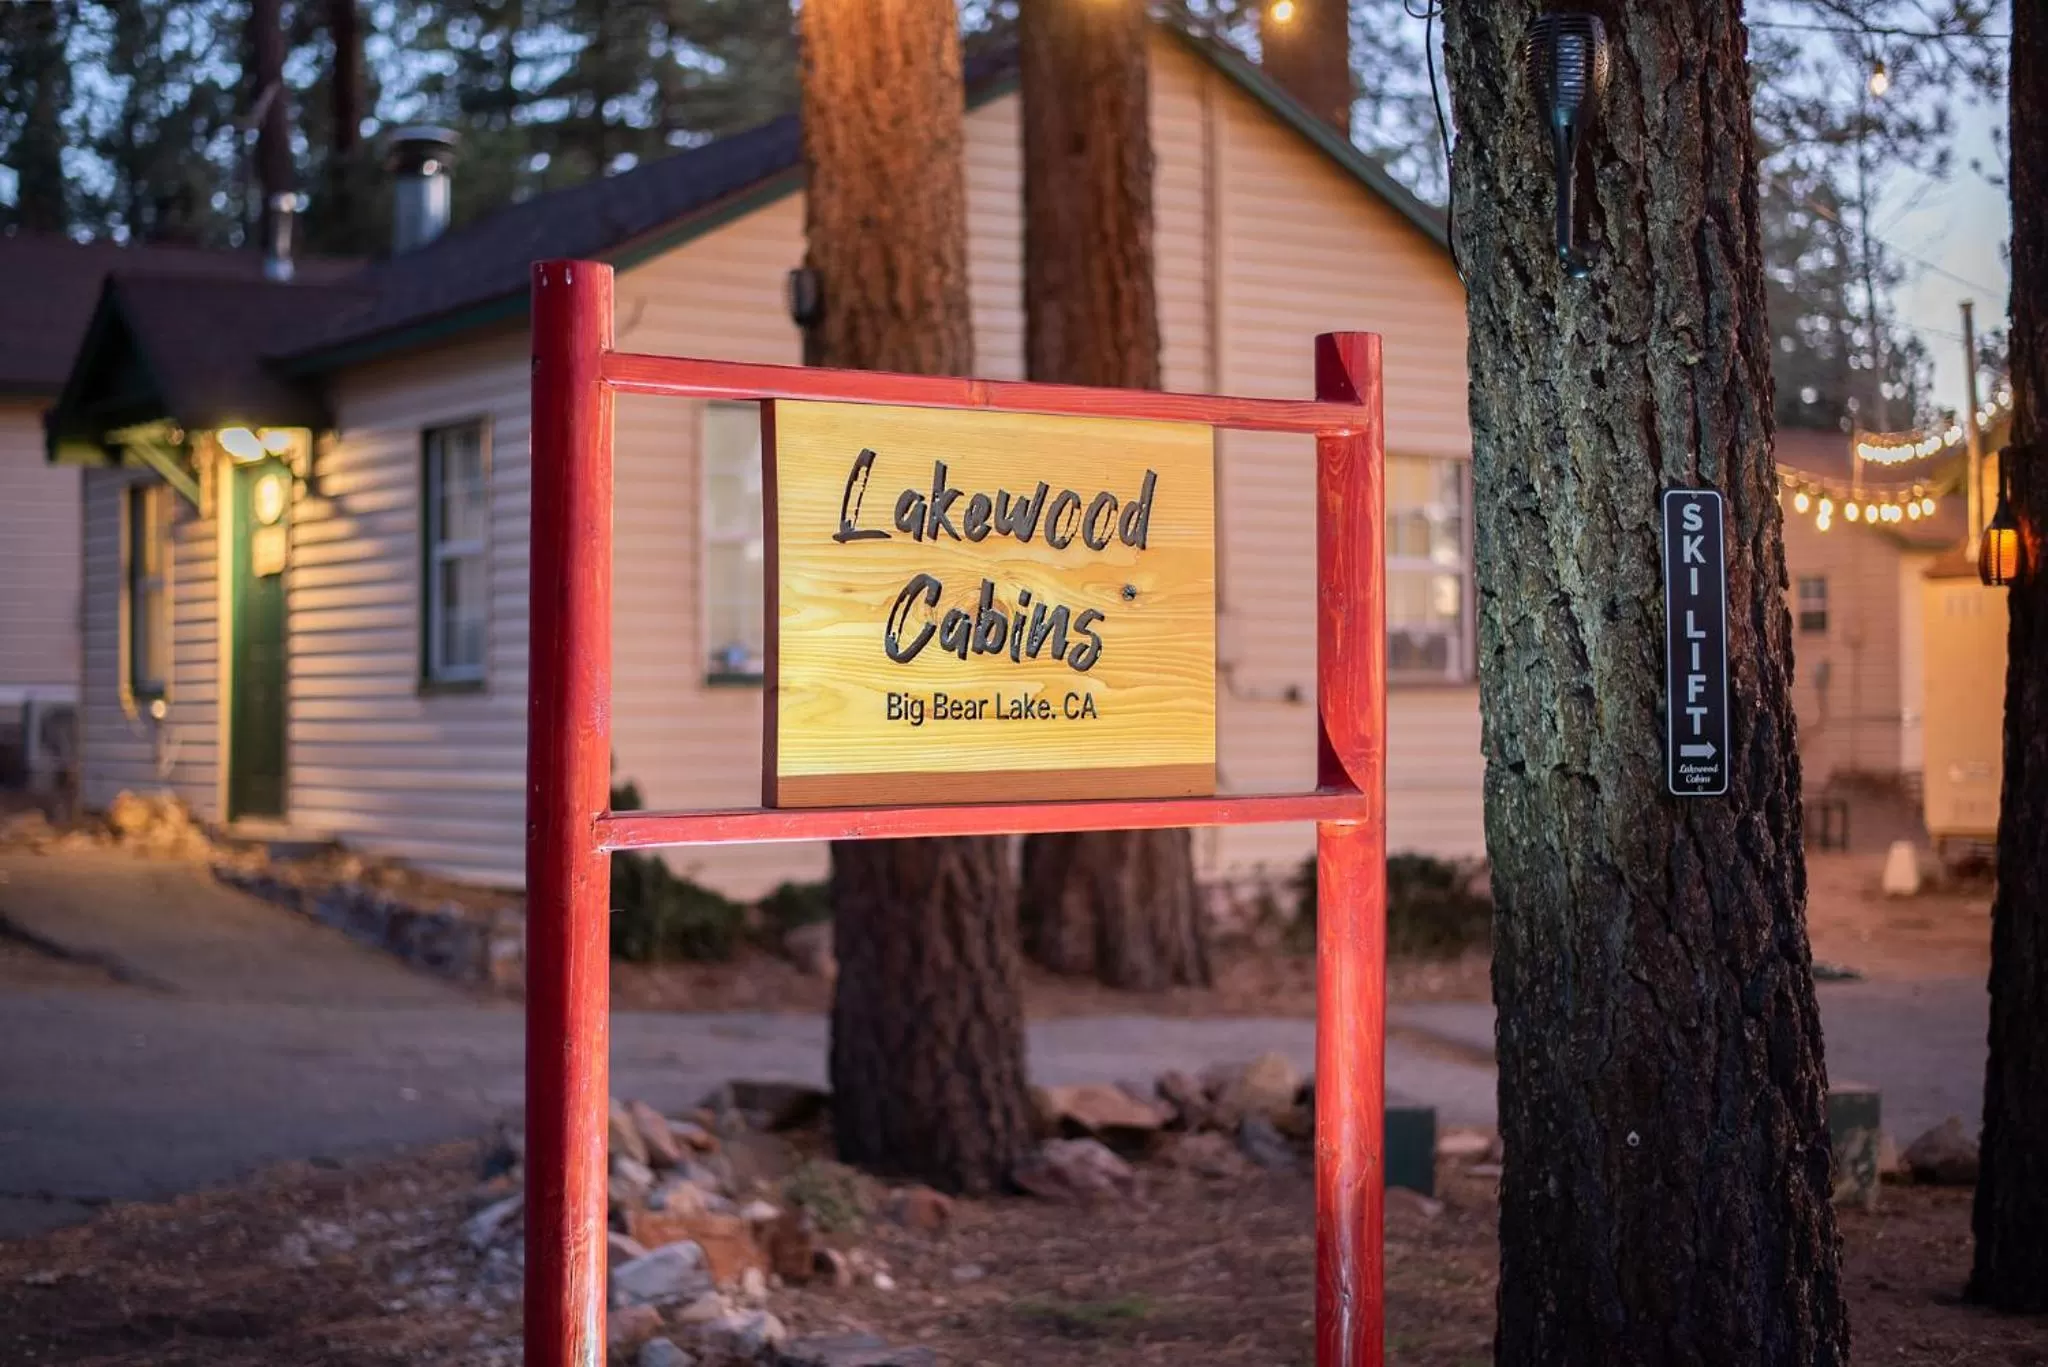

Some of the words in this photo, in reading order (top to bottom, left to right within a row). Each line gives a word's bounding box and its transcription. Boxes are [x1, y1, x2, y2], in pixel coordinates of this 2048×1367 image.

[832, 447, 1158, 551] Lakewood
[1682, 503, 1706, 596] SKI
[884, 573, 1105, 672] Cabins
[886, 691, 924, 725] Big
[933, 692, 989, 720] Bear
[1064, 692, 1097, 719] CA
[1686, 610, 1708, 736] LIFT
